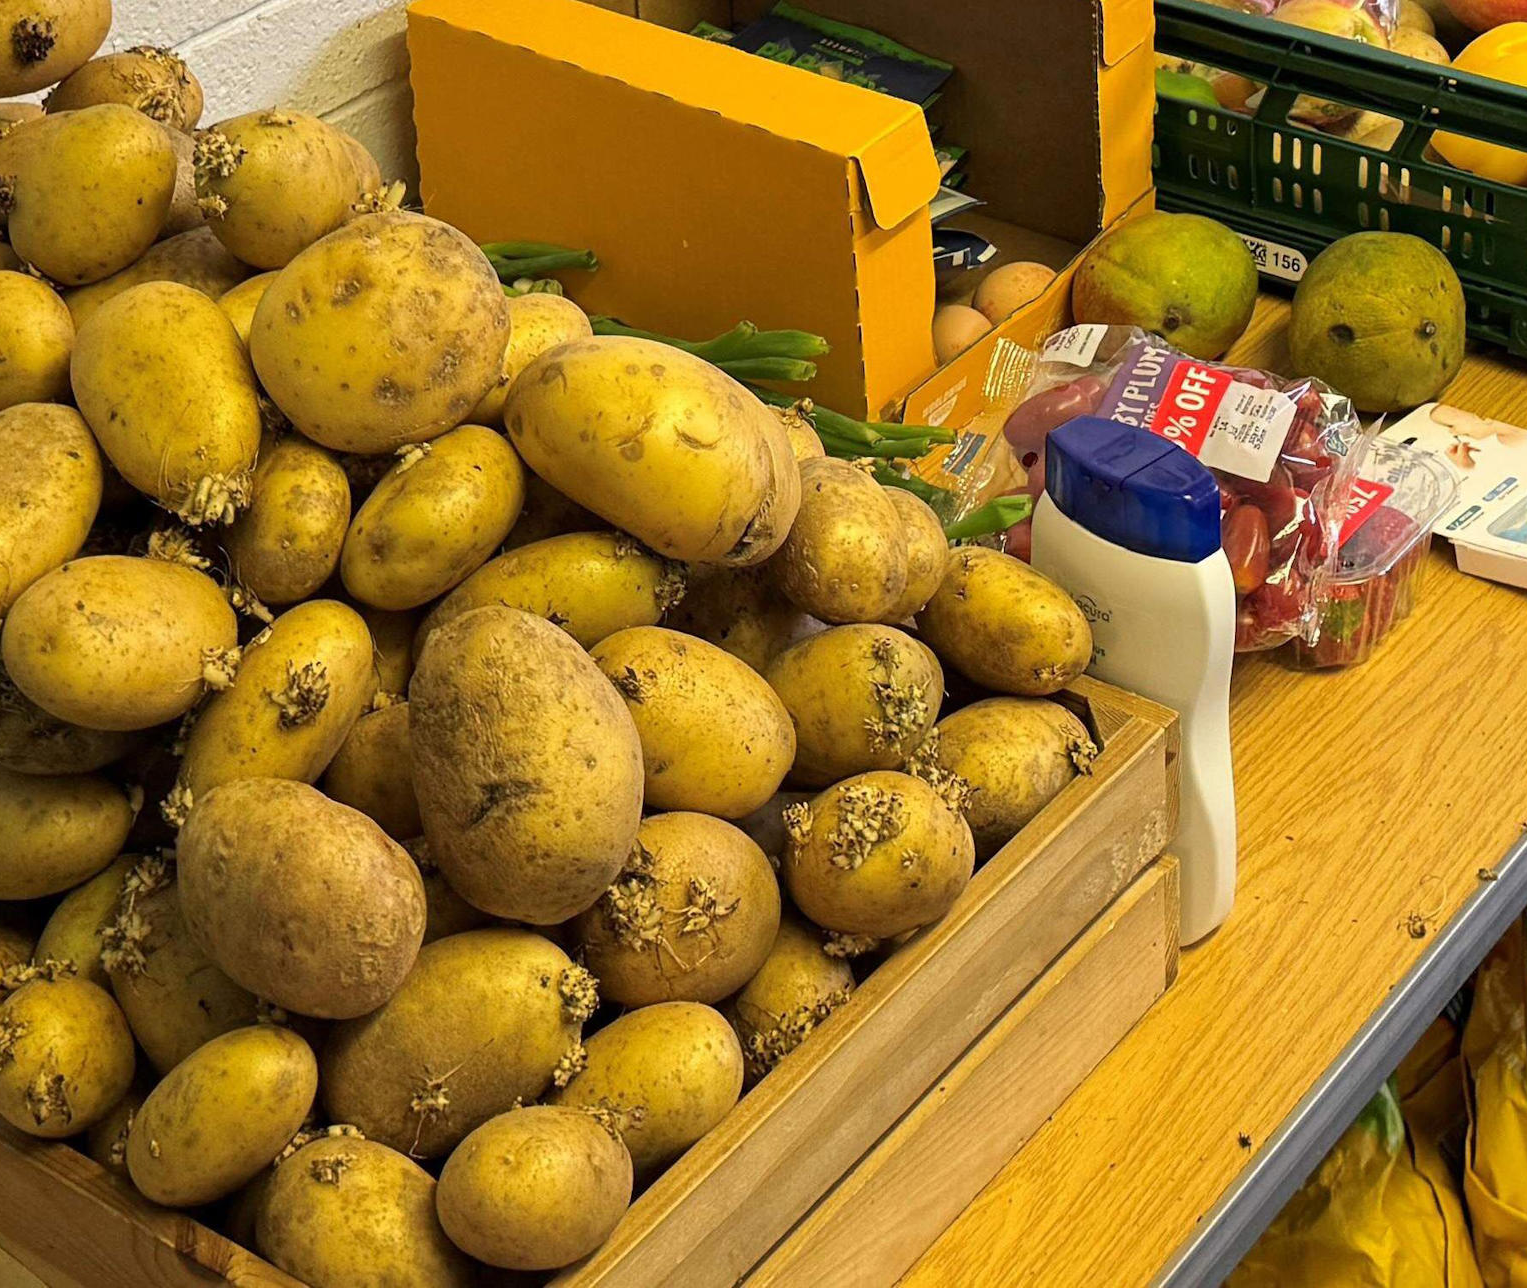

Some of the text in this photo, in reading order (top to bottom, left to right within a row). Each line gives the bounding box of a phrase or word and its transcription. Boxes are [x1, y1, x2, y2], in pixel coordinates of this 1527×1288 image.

[1272, 252, 1301, 272] 156
[1110, 345, 1171, 427] BY PLUM
[1175, 367, 1217, 412] OFF
